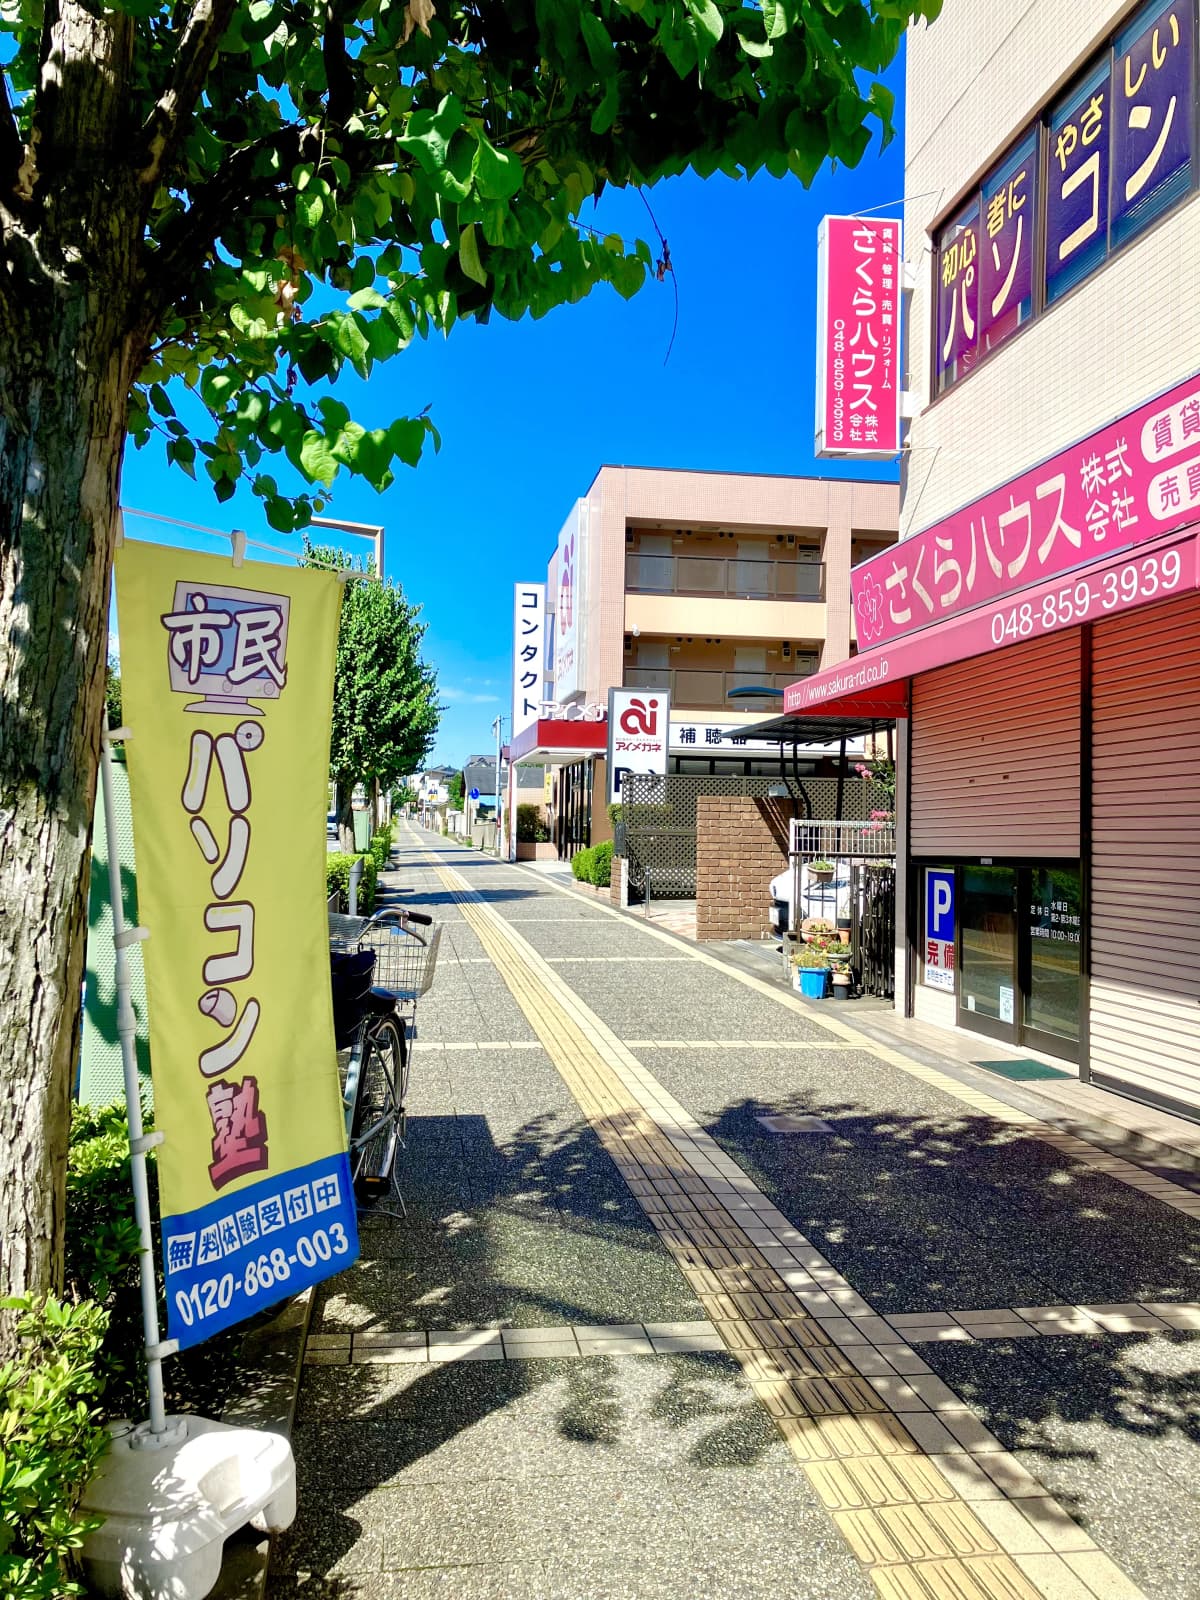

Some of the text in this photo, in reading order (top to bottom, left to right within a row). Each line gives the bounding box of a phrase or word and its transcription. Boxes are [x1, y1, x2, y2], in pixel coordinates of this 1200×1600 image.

[943, 96, 1176, 361] パソコン
[849, 225, 879, 410] さくらハウス
[833, 319, 845, 441] 048-859-3939
[1152, 399, 1200, 454] 賃貸
[885, 472, 1082, 626] さくらハウス
[991, 550, 1181, 645] 048-859-3939
[161, 592, 287, 689] 市民
[520, 592, 539, 716] コンタクト
[787, 657, 889, 708] http//www.sakura-rd.co.jp
[615, 741, 662, 753] アイメガネ
[182, 719, 268, 1191] パソコン塾
[933, 879, 952, 932] P
[168, 1173, 342, 1274] 無料体験受付中
[175, 1222, 348, 1327] 0120-868-003
